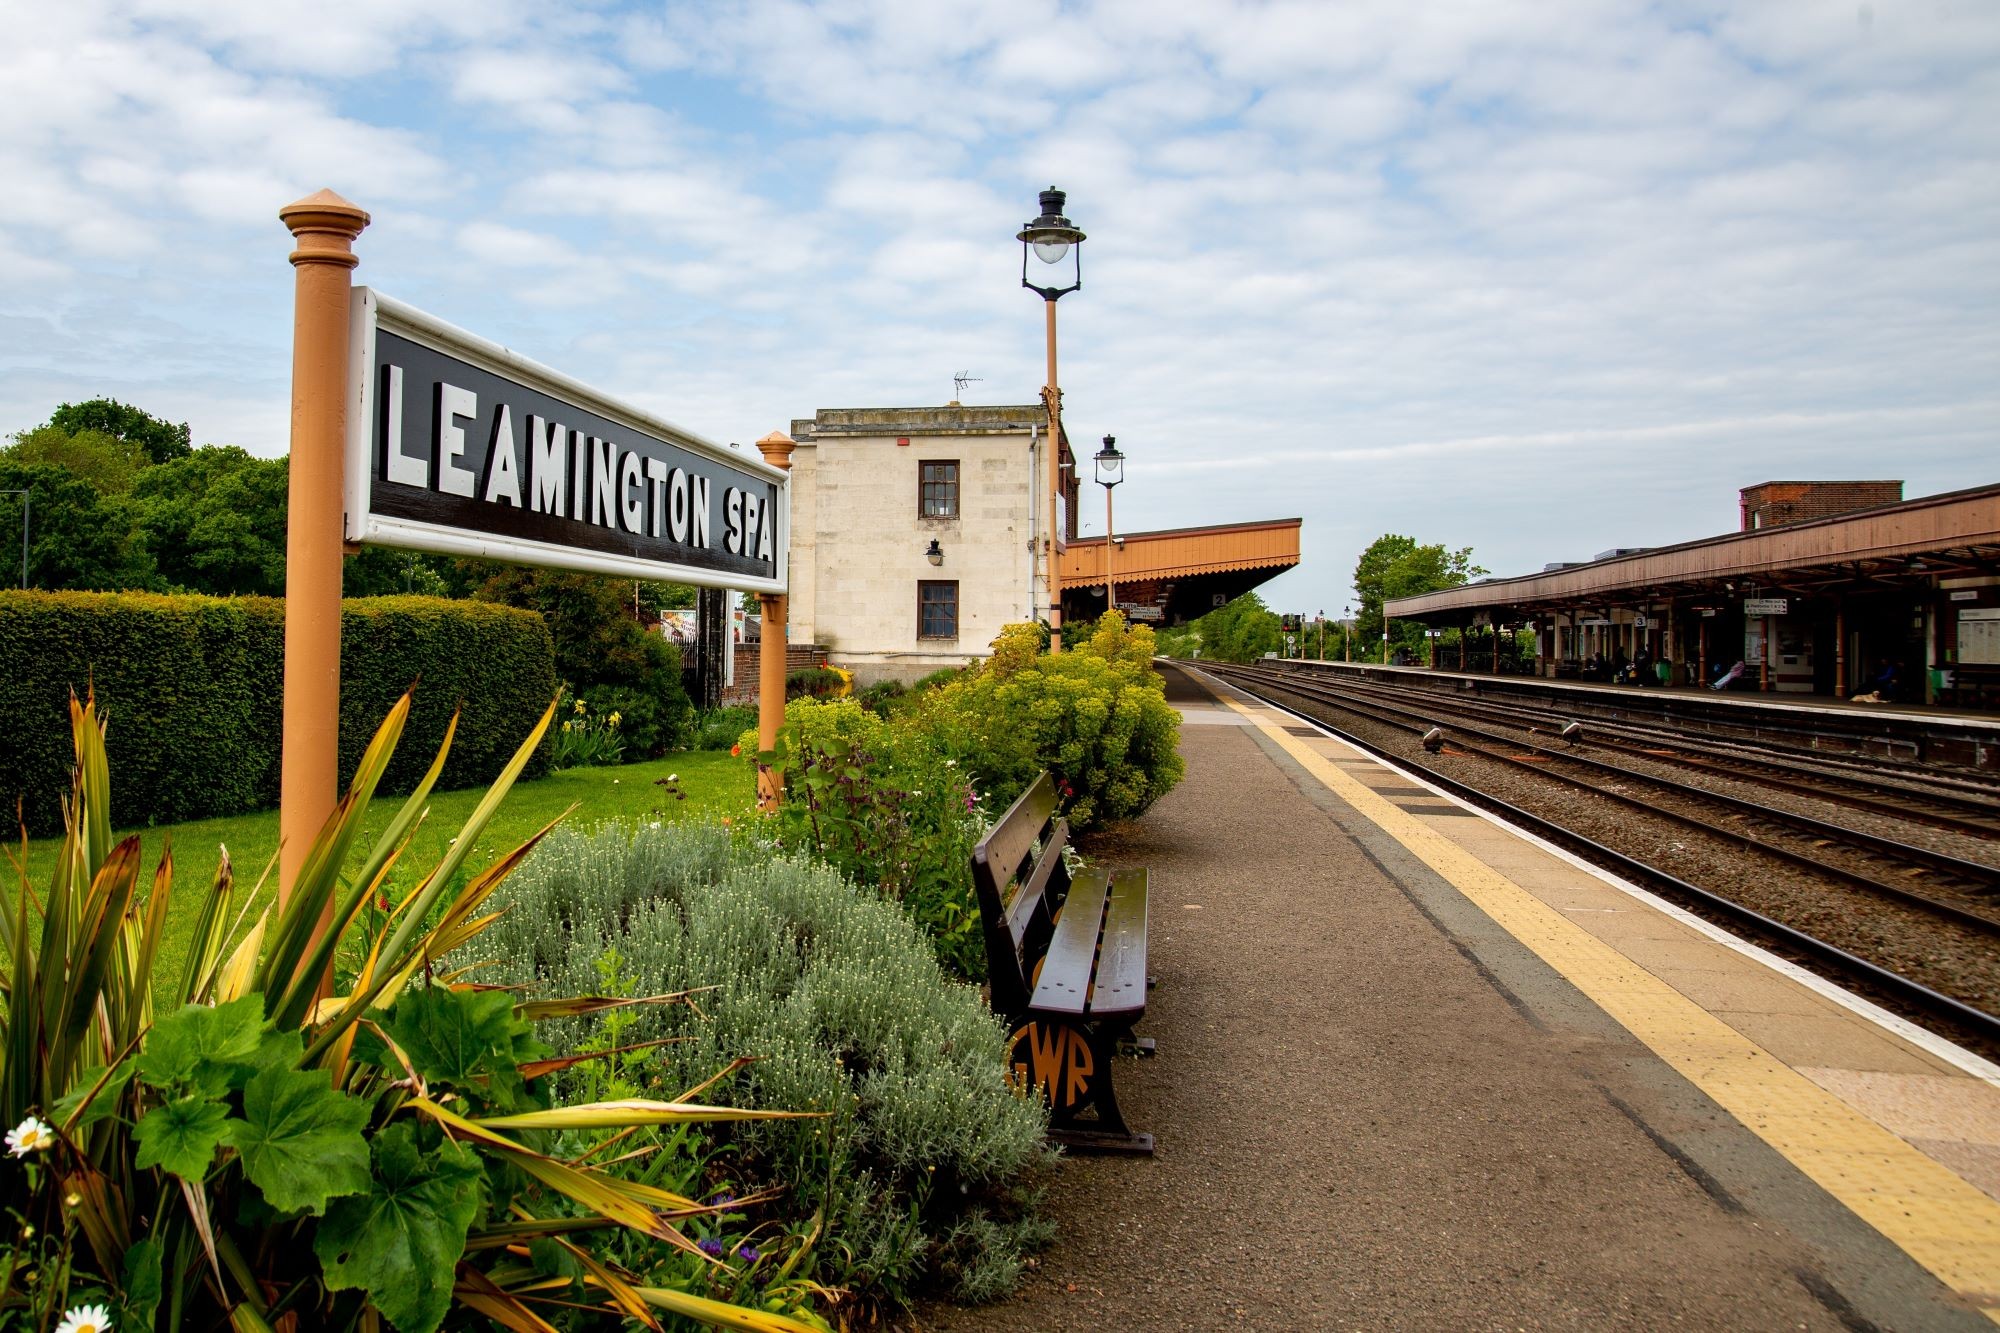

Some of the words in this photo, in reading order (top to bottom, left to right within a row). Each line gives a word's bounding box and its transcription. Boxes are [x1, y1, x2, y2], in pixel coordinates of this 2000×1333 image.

[380, 363, 710, 549] LEAMINGTON
[722, 487, 773, 562] SPA
[1215, 595, 1223, 605] 2
[1637, 618, 1643, 626] 3
[1004, 1021, 1094, 1108] GWR
